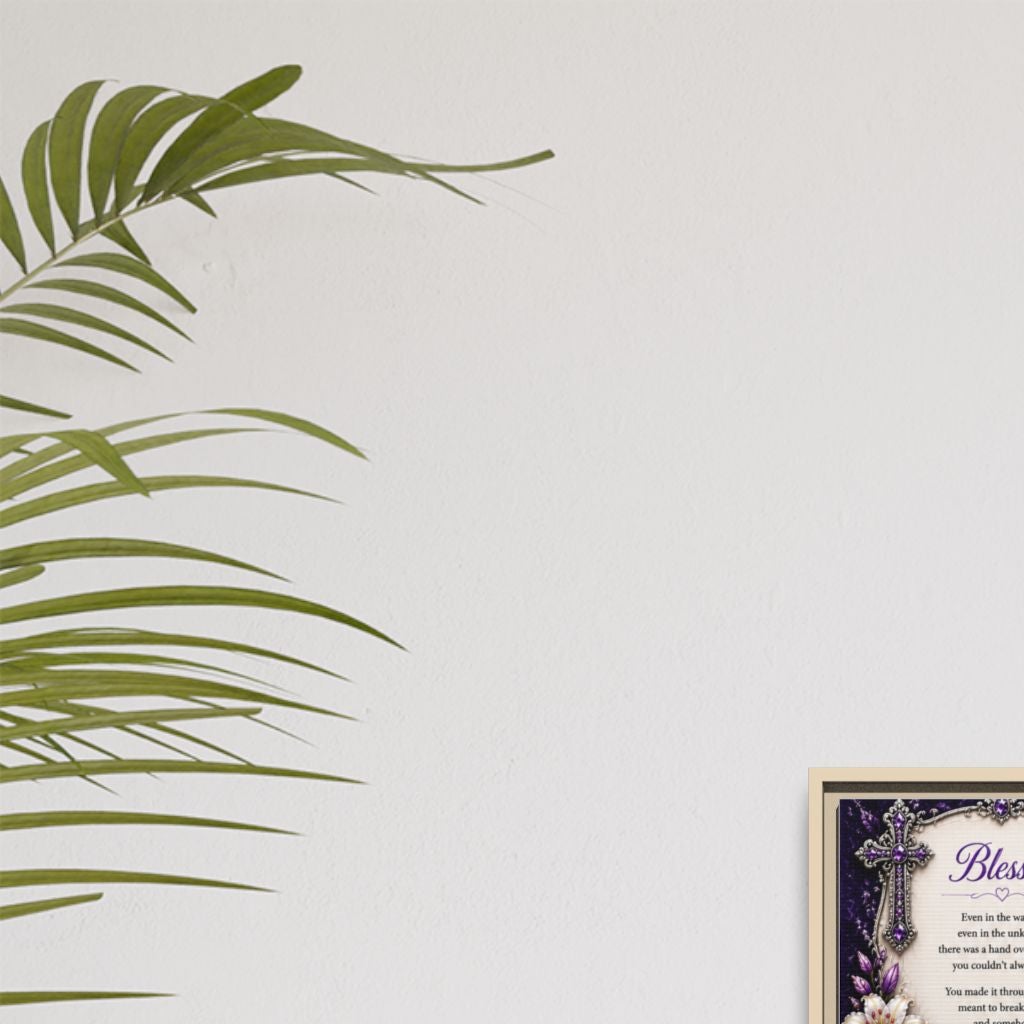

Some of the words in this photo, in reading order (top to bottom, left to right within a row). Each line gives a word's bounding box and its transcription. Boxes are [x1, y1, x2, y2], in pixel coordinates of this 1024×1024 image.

[961, 912, 983, 922] Even
[985, 912, 994, 922] in
[996, 911, 1011, 922] the
[957, 930, 978, 938] even
[980, 928, 989, 938] in
[991, 927, 1006, 938] the
[938, 943, 961, 954] there
[963, 946, 980, 954] was
[981, 946, 987, 954] a
[988, 943, 1011, 954] hand
[952, 962, 969, 973] you
[970, 960, 1008, 970] couldn't
[945, 986, 963, 997] You
[964, 986, 989, 997] made
[991, 986, 998, 997] it
[958, 1003, 986, 1013] meant
[988, 1003, 998, 1013] to
[1000, 1002, 1024, 1012] break
